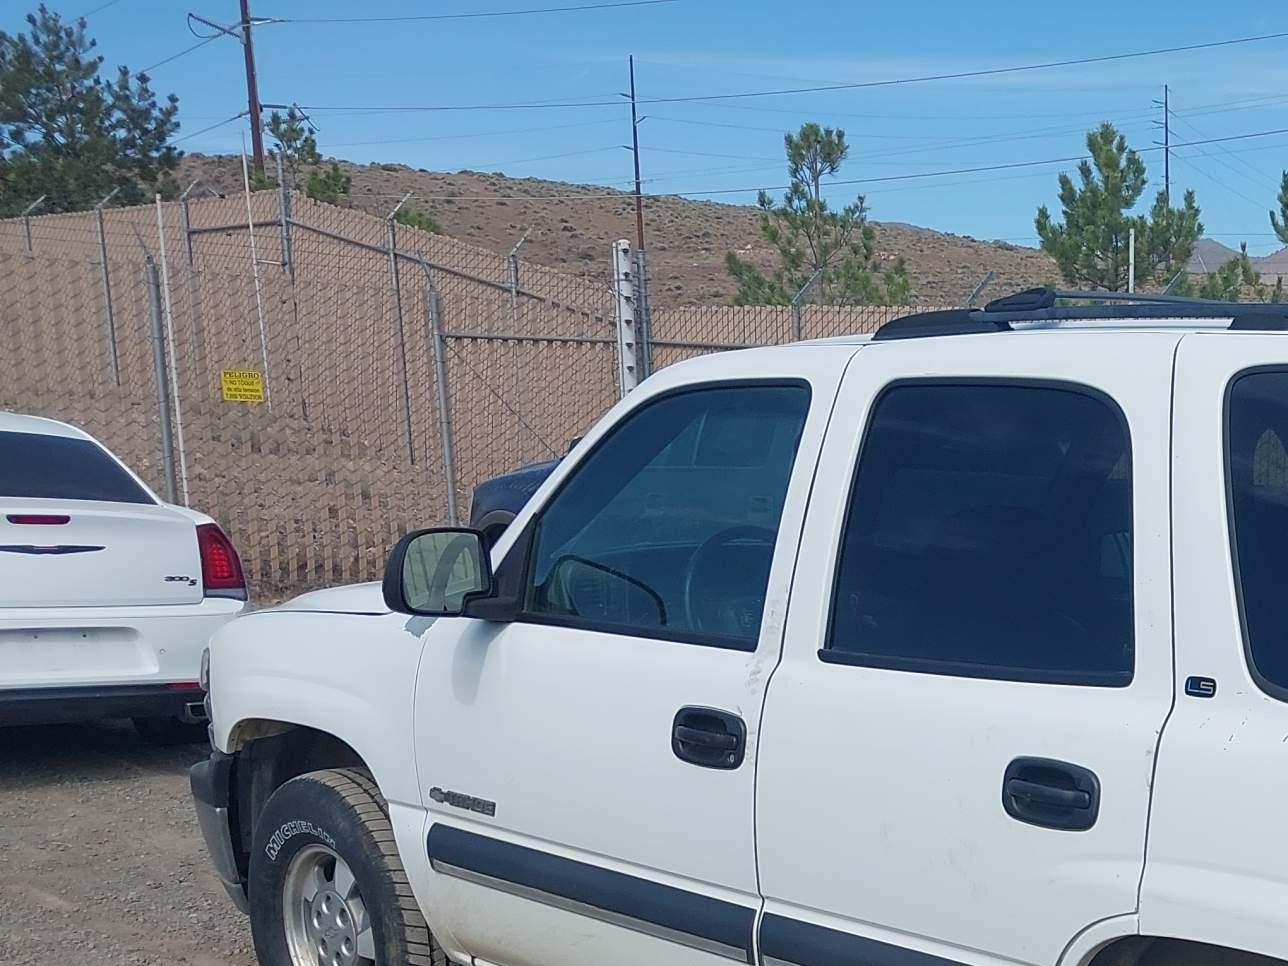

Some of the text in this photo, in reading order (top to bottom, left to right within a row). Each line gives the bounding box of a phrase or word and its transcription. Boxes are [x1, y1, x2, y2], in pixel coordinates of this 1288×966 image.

[223, 371, 260, 380] PELIGRO
[1187, 679, 1215, 695] LS
[265, 820, 336, 861] MICHELIN
